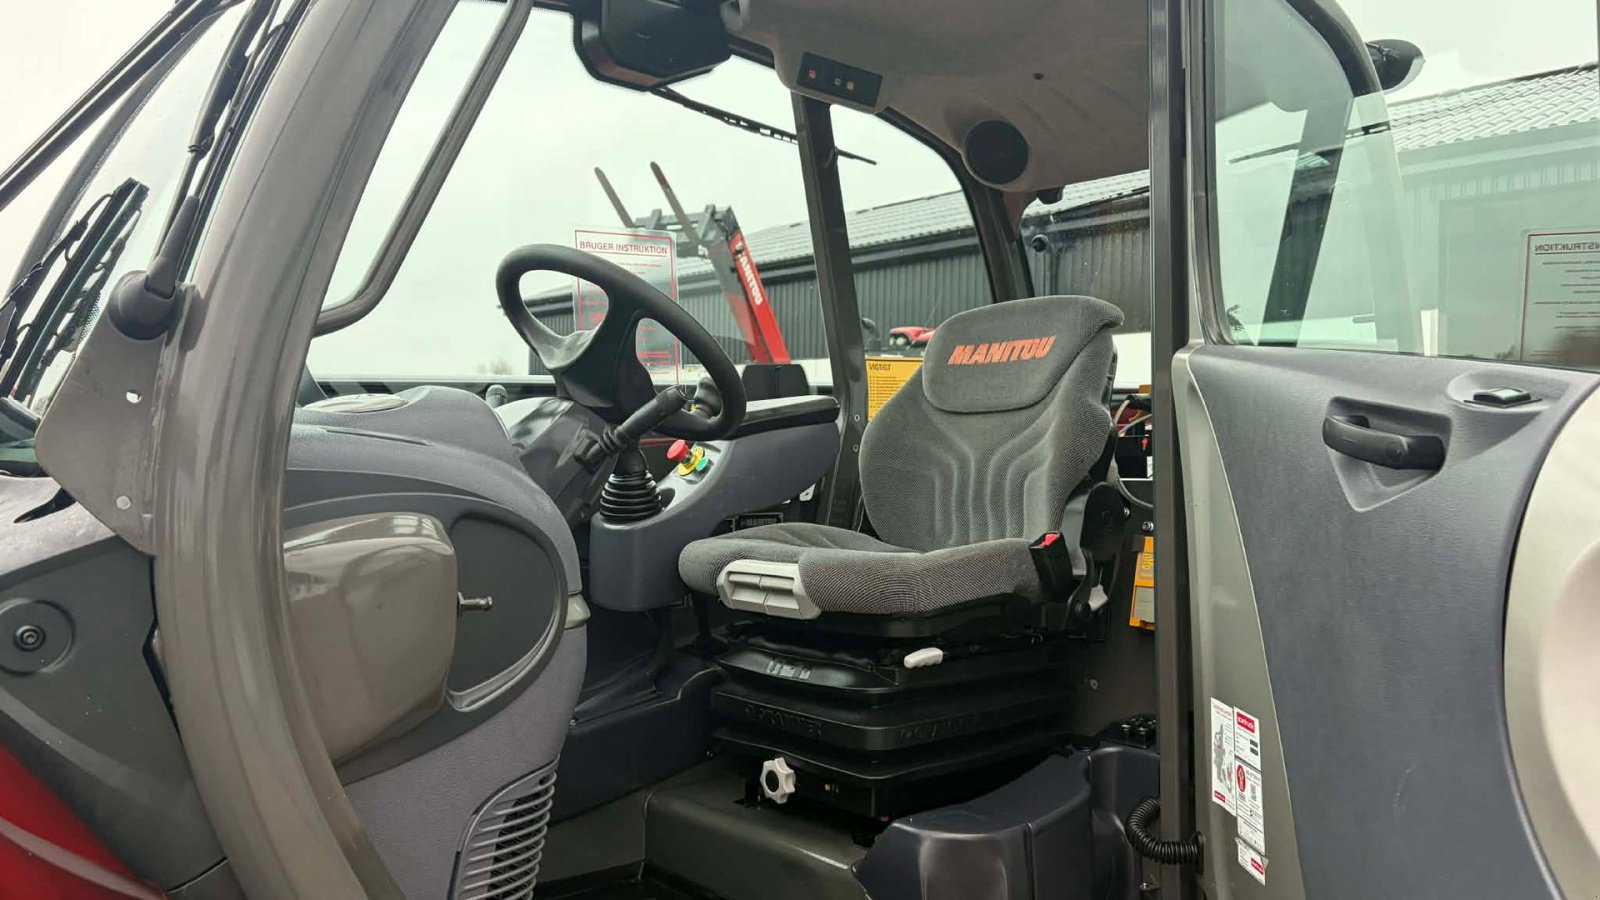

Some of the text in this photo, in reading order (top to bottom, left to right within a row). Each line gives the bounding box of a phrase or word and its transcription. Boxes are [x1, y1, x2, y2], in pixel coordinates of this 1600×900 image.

[580, 240, 667, 254] BRUGER INSTRUKTION
[947, 335, 1056, 365] MANITOU
